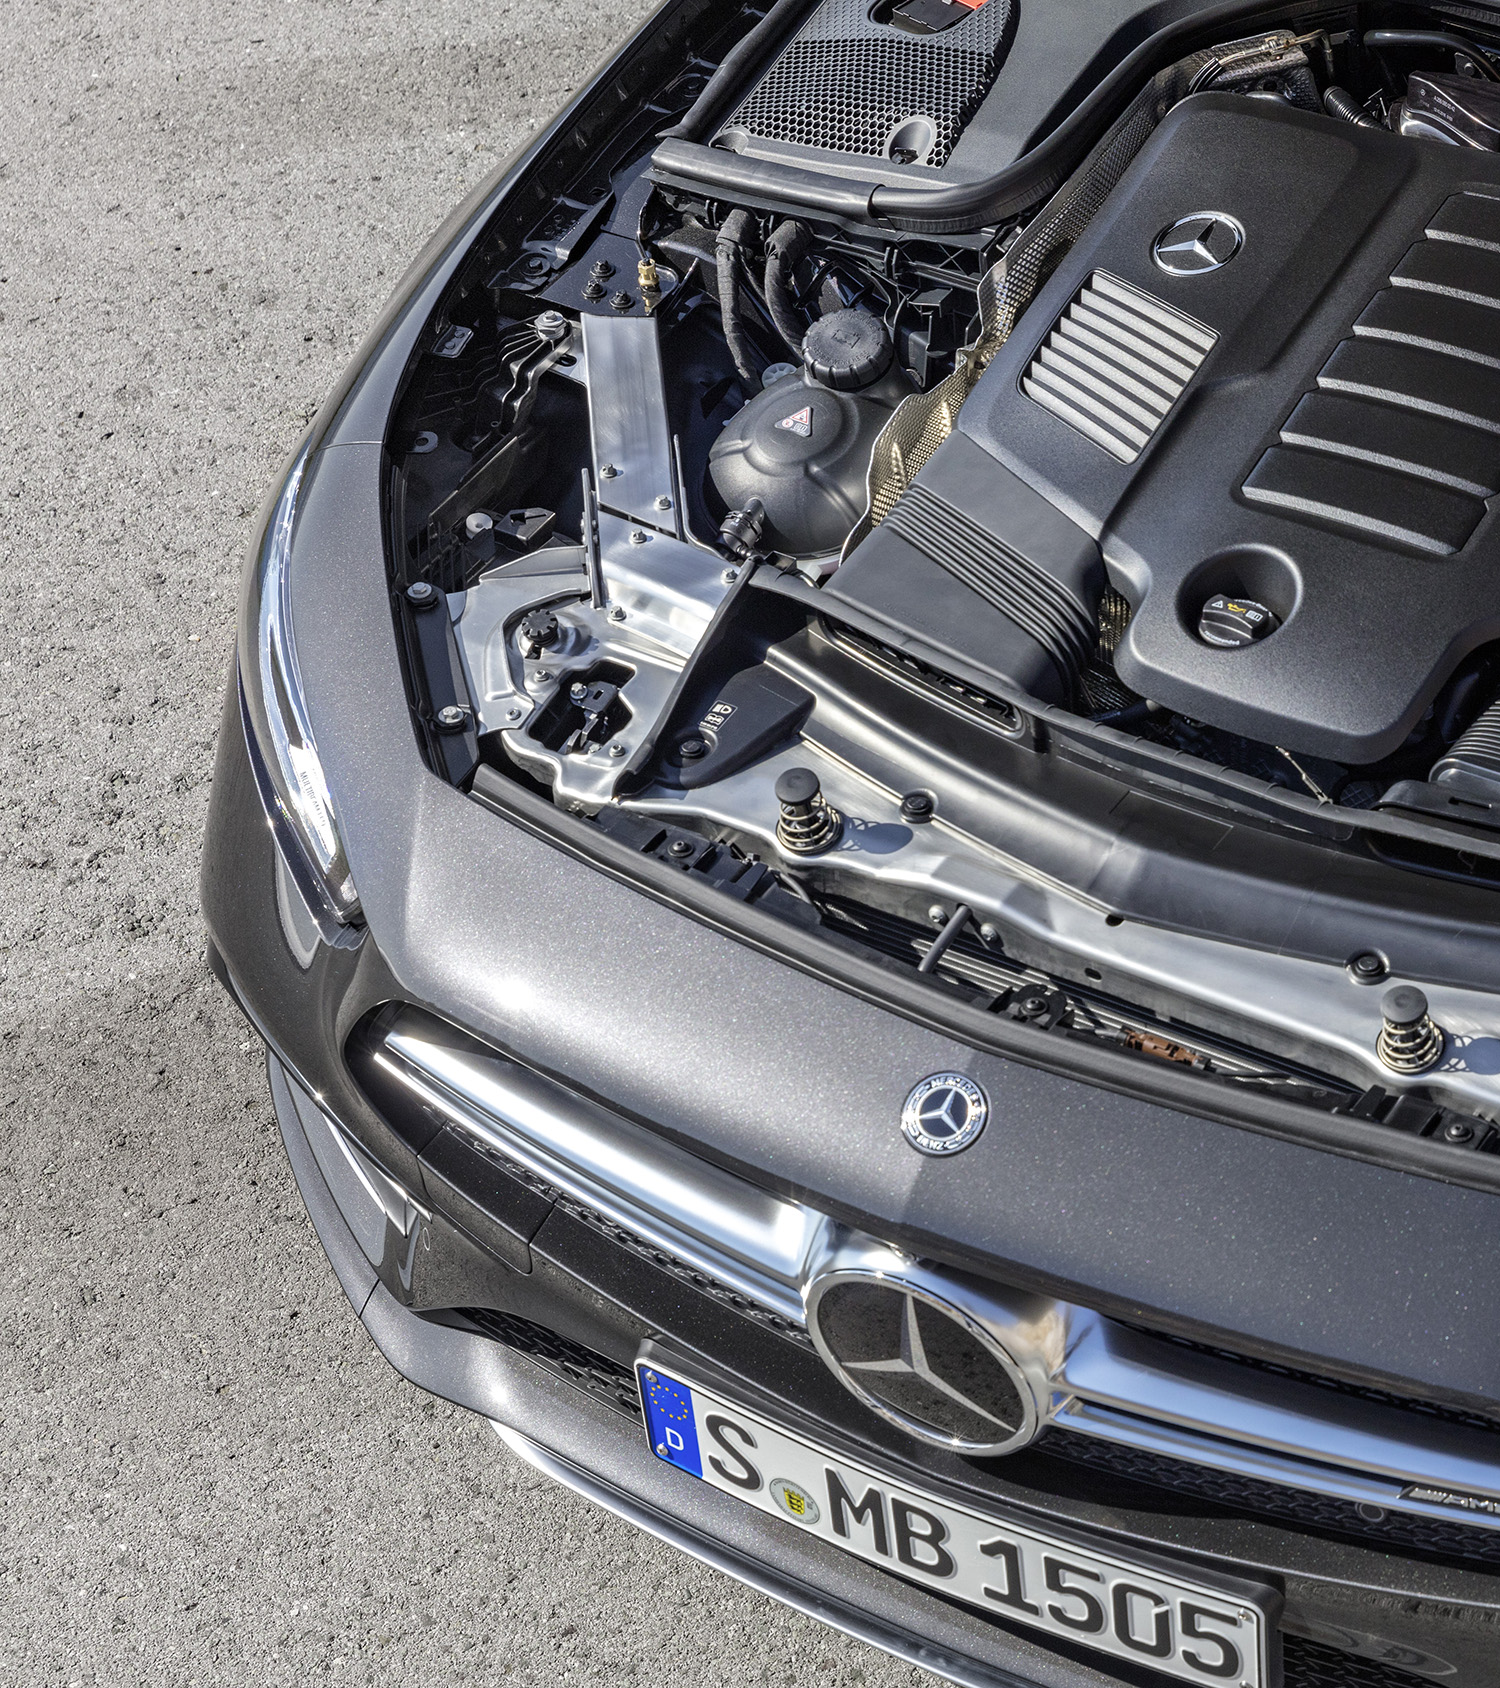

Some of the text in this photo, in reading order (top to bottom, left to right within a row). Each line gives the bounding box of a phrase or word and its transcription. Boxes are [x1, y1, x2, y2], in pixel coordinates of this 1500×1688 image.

[665, 1427, 684, 1451] D
[705, 1414, 1240, 1678] S MB 1505
